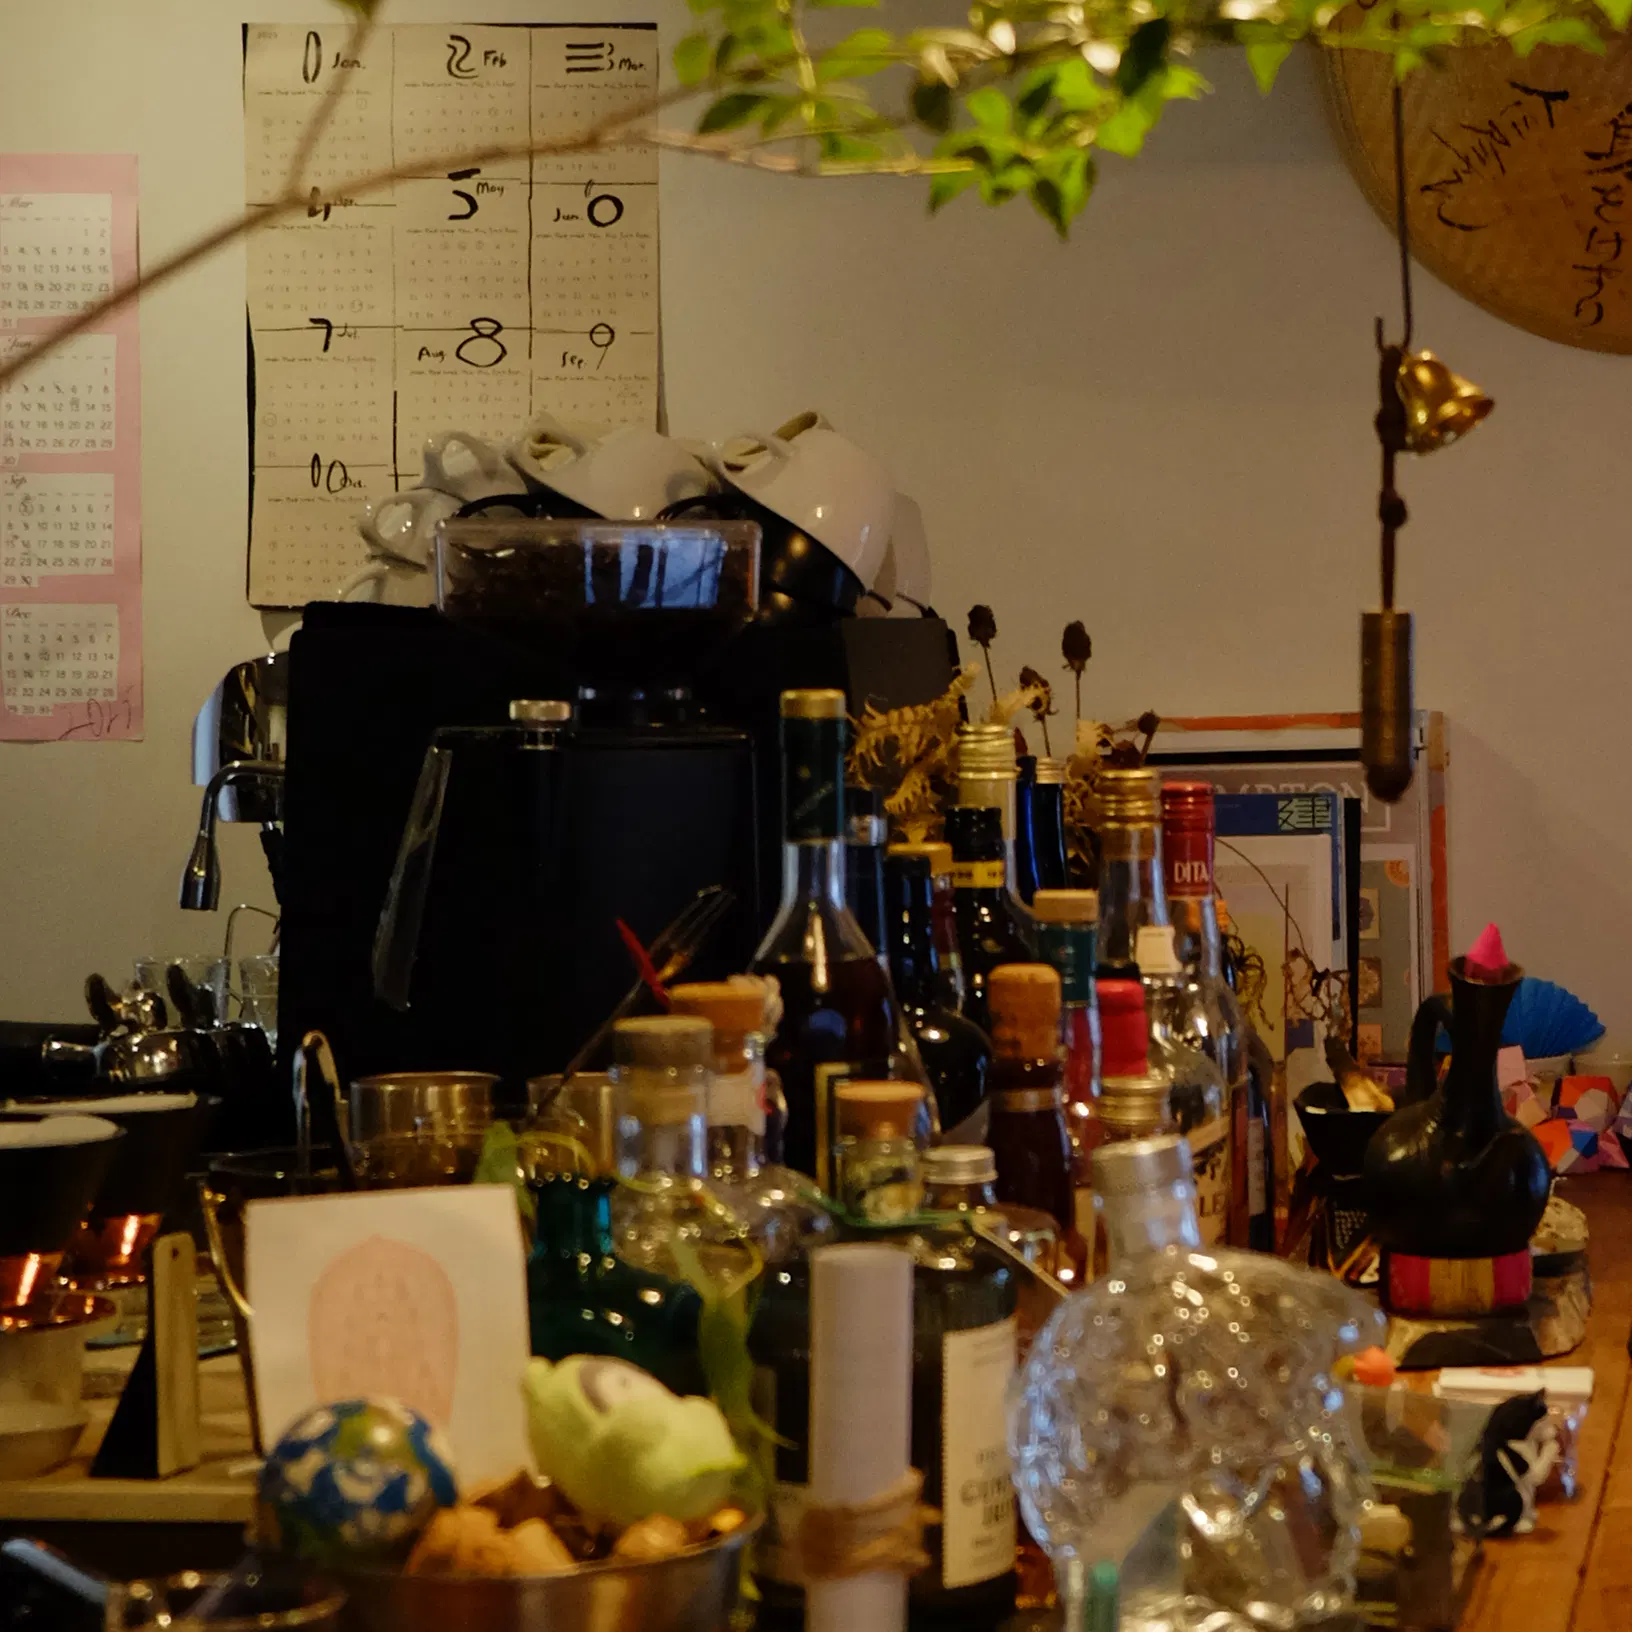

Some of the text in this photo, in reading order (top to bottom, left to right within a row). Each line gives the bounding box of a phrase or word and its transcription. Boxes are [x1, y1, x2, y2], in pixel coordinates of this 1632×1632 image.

[476, 181, 506, 199] May
[308, 317, 334, 353] 7
[455, 316, 508, 369] 8
[589, 321, 617, 372] 9
[1173, 860, 1210, 885] DITA
